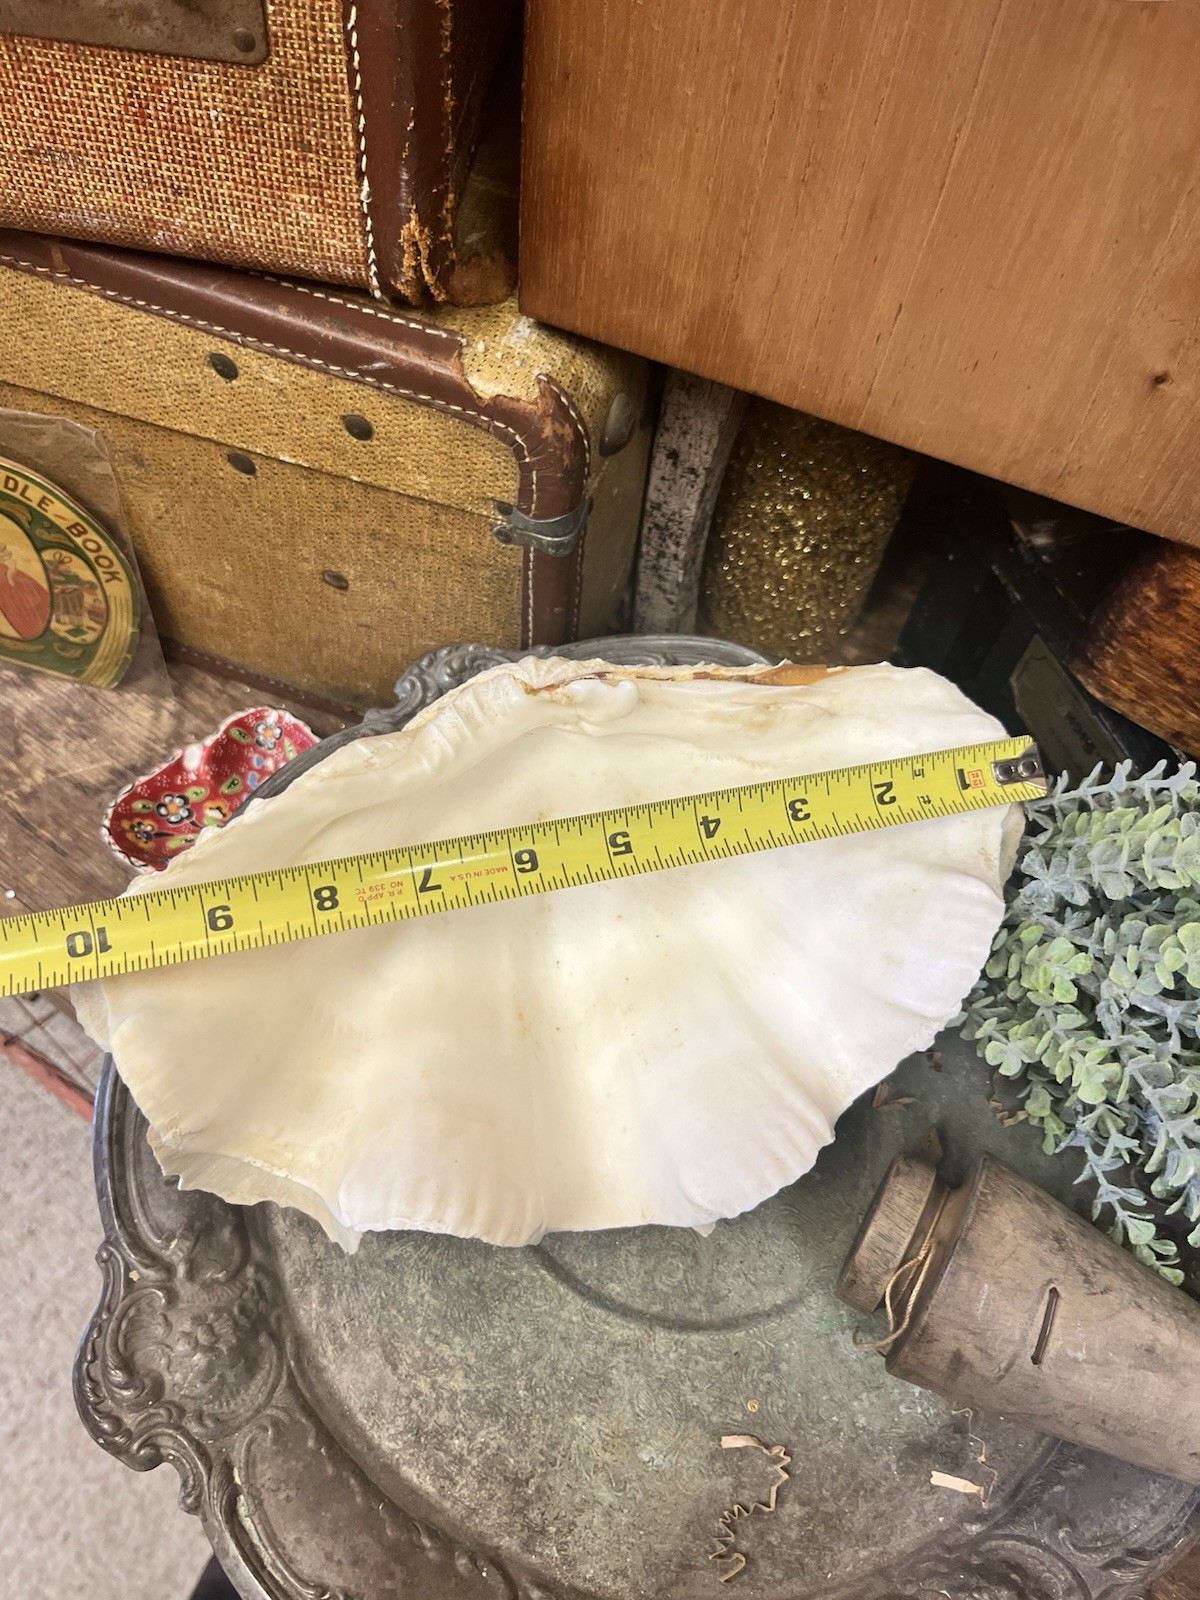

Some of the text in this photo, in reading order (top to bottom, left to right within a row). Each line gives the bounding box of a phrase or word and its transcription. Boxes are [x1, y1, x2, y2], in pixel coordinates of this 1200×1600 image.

[65, 521, 123, 584] BOOK
[972, 779, 983, 787] 12
[920, 795, 931, 805] ft
[66, 768, 971, 959] 1 2 3 4 5 6 7 8 9 10
[473, 870, 482, 878] IN
[485, 865, 508, 876] MADE
[369, 883, 386, 892] 339
